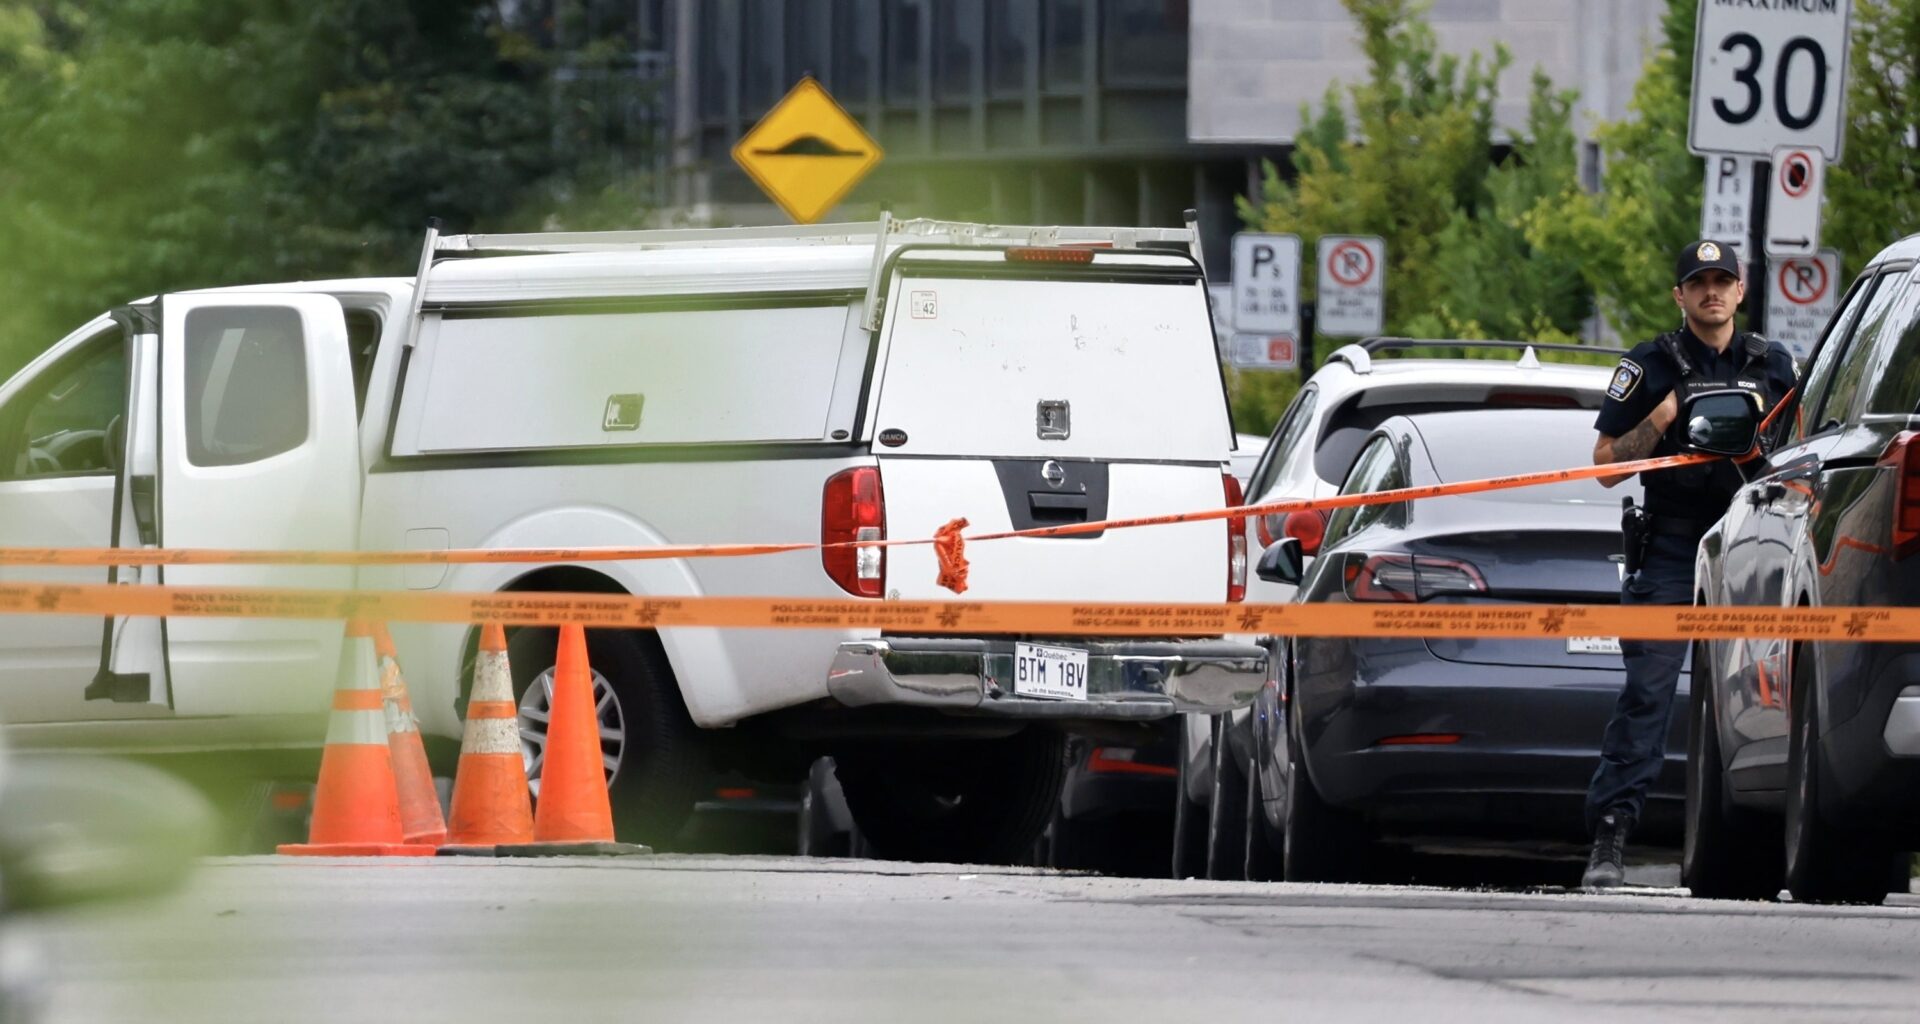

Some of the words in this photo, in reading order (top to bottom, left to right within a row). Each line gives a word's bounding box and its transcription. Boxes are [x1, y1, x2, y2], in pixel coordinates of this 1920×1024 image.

[1714, 0, 1837, 14] XIMUM
[1711, 31, 1827, 131] 30
[922, 302, 936, 315] 42
[1619, 360, 1641, 377] POLICE
[880, 433, 906, 441] RANCH
[172, 592, 215, 602] POLICE
[471, 600, 513, 610] POLICE
[517, 601, 571, 610] PASSAGE
[771, 604, 813, 613] POLICE
[818, 605, 870, 614] PASSAGE
[875, 605, 930, 614] INTERDIT
[471, 611, 540, 620] INFO-CRIME
[1072, 607, 1114, 616] POLICE
[1118, 607, 1172, 617] PASSAGE
[1176, 608, 1231, 617] INTERDIT
[1373, 609, 1415, 619] POLICE
[1419, 610, 1473, 619] PASSAGE
[1477, 610, 1533, 620] INTERDIT
[771, 615, 840, 624] INFO-CRIME
[1676, 612, 1719, 622] POLICE
[1722, 612, 1777, 622] PASSAGE
[1781, 613, 1836, 623] INTERDIT
[1072, 618, 1141, 628] INFO-CRIME
[1149, 618, 1169, 628] 514
[1374, 620, 1443, 630] INFO-CRIME
[1677, 624, 1746, 633] INFO-CRIME
[1753, 624, 1775, 634] 514
[1018, 656, 1047, 684] BTM
[1058, 661, 1086, 689] 18V
